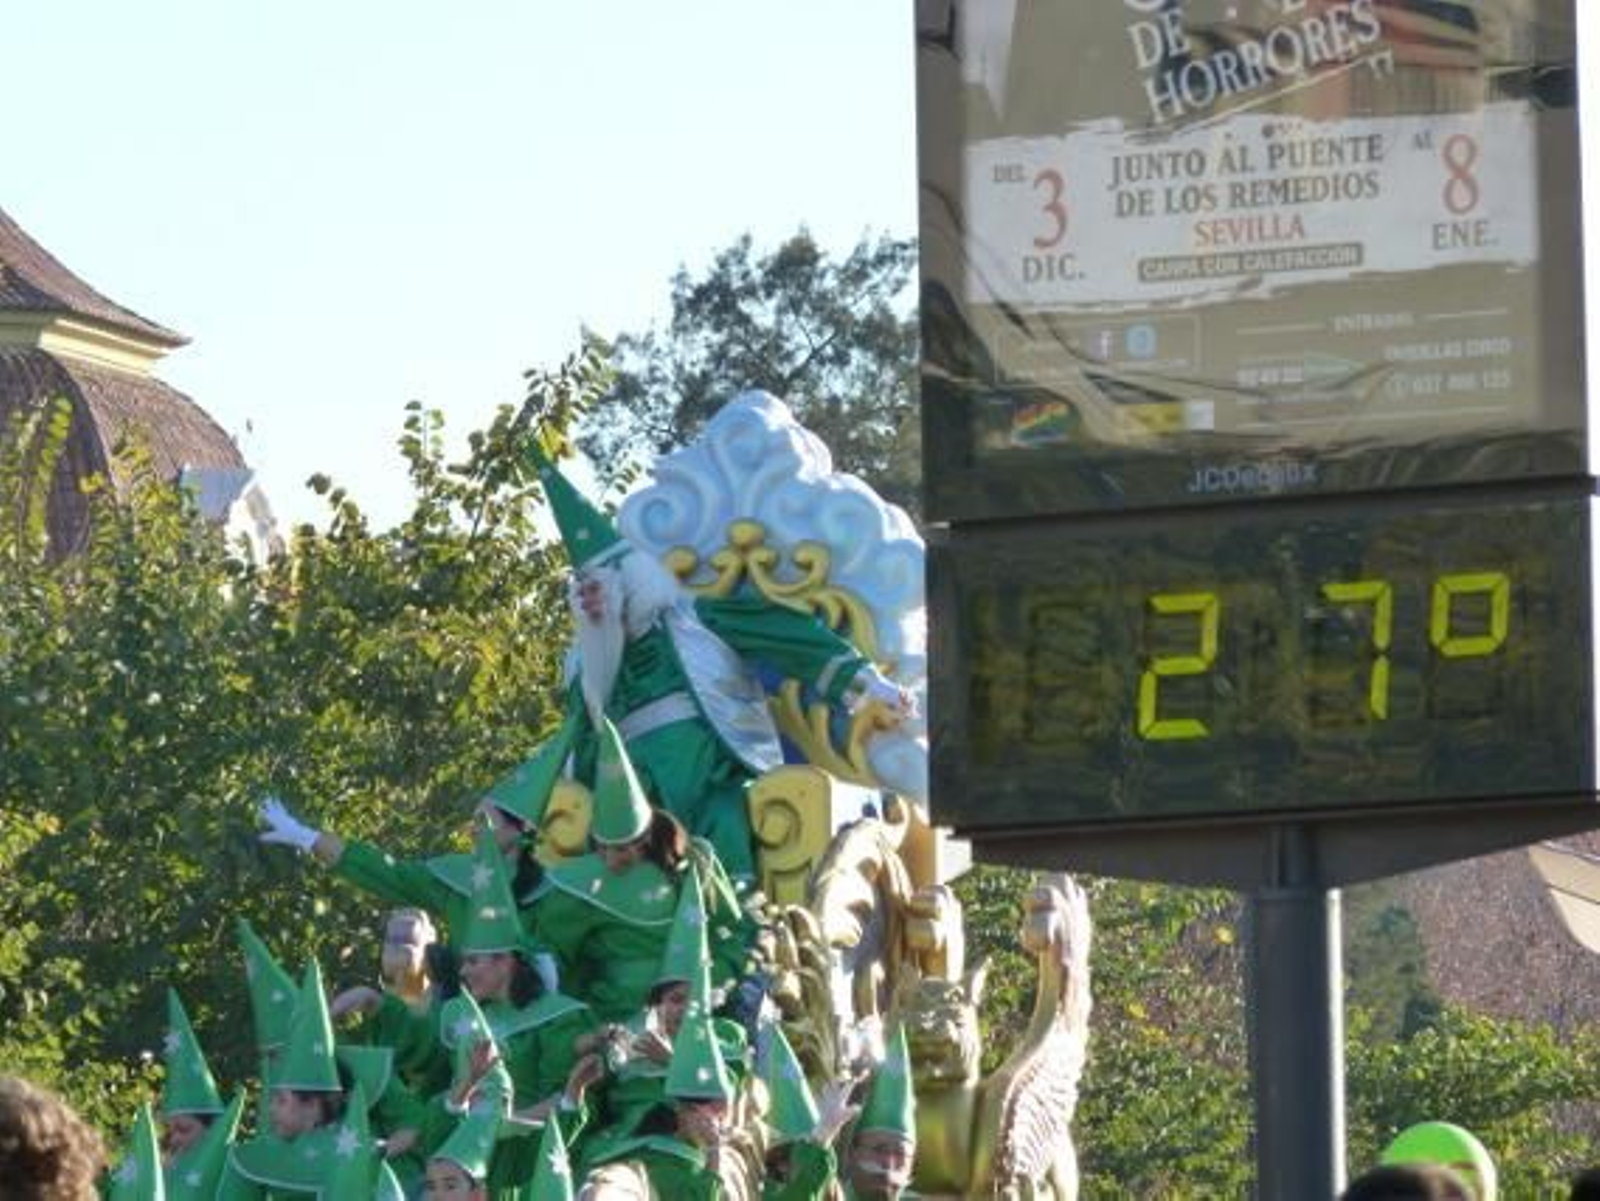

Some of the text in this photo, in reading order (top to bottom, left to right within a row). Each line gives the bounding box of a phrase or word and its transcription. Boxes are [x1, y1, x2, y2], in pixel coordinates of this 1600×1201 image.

[1127, 7, 1189, 69] DE
[1144, 0, 1381, 123] HORRORES
[1107, 133, 1384, 191] JUNTO AL PUENTE
[1442, 133, 1480, 215] 8
[1033, 168, 1068, 248] 3
[1114, 170, 1381, 218] DE LOS REMEDIOS
[1194, 213, 1306, 248] SEVILLA
[1022, 253, 1086, 284] DIC.
